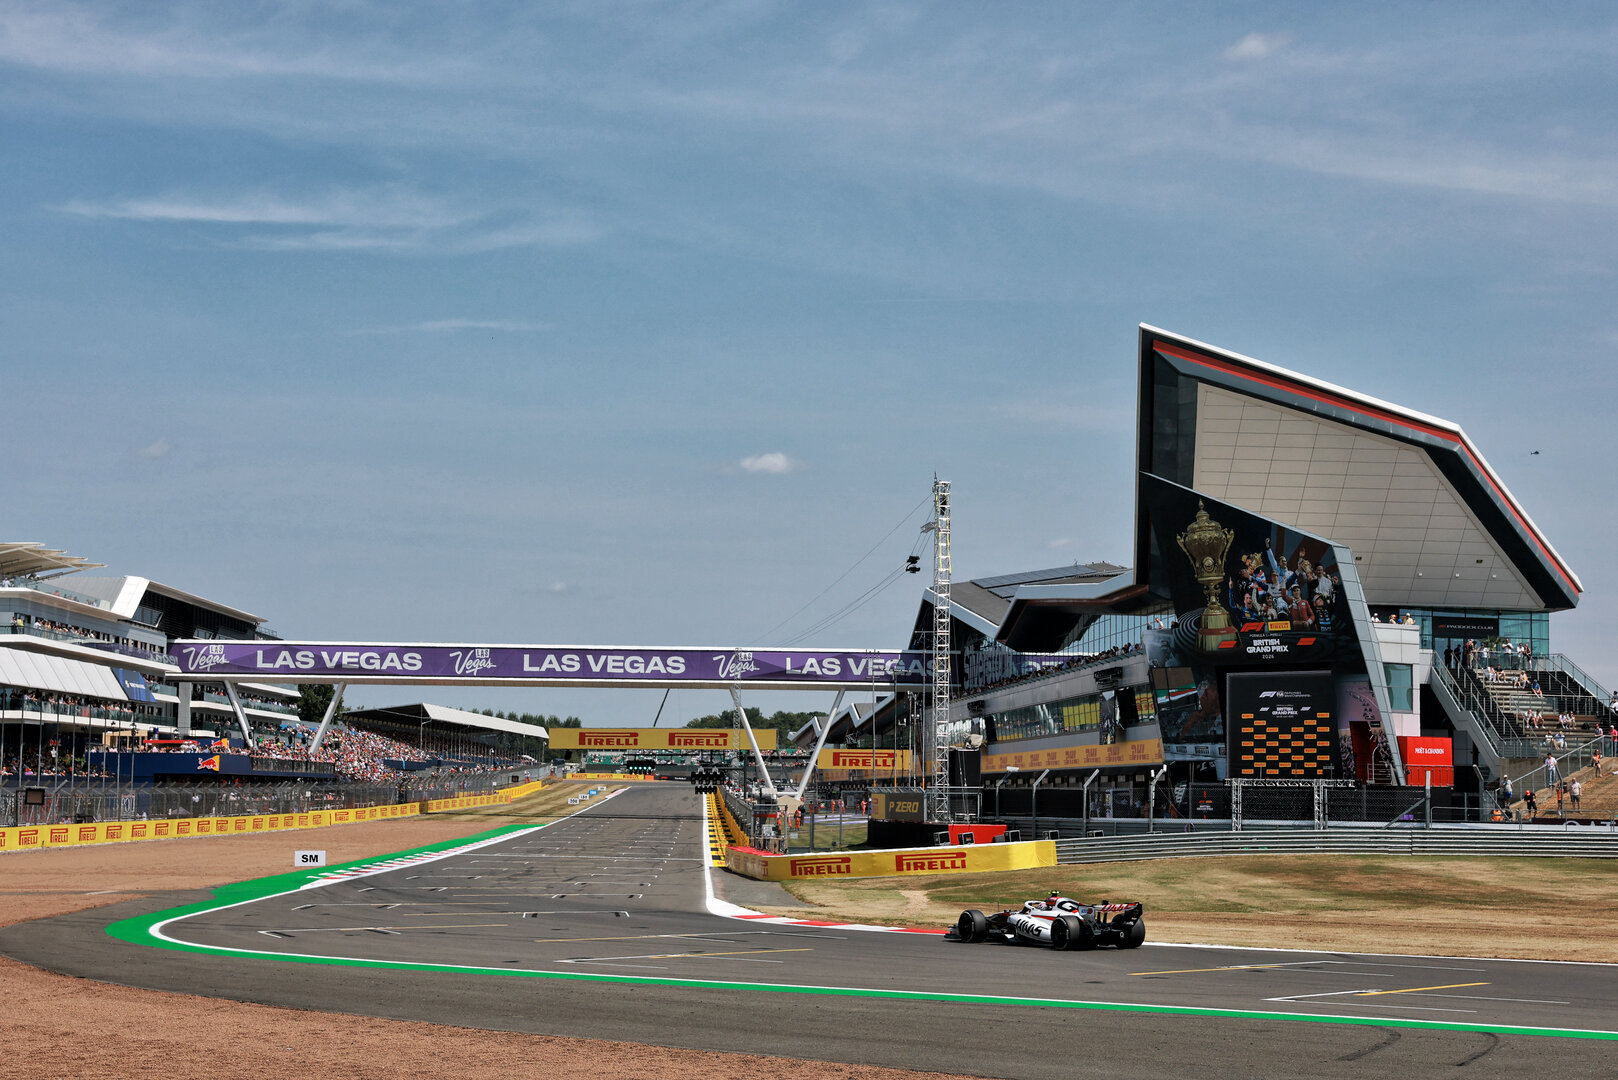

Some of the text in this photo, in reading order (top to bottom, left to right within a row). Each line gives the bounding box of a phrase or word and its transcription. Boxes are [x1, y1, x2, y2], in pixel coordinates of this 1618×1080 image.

[209, 645, 224, 654] LAS
[475, 649, 490, 658] LAS
[183, 646, 230, 671] Vegas
[256, 650, 423, 671] LAS VEGAS
[449, 650, 497, 676] Vegas
[523, 653, 686, 674] LAS VEGAS
[712, 654, 760, 679] Vegas
[785, 657, 841, 676] LAS
[579, 732, 639, 746] PIRELLI
[668, 733, 729, 746] PIRELLI
[833, 752, 898, 768] PIRELLI
[895, 802, 919, 813] ZERO
[19, 830, 39, 846] PIRELLI
[50, 828, 69, 843] PIRELLI
[79, 826, 97, 841] PIRELLI
[106, 825, 122, 839] PIRELLI
[301, 854, 319, 863] SM
[790, 857, 851, 876] PIRELLI
[895, 852, 967, 871] PIRELLI
